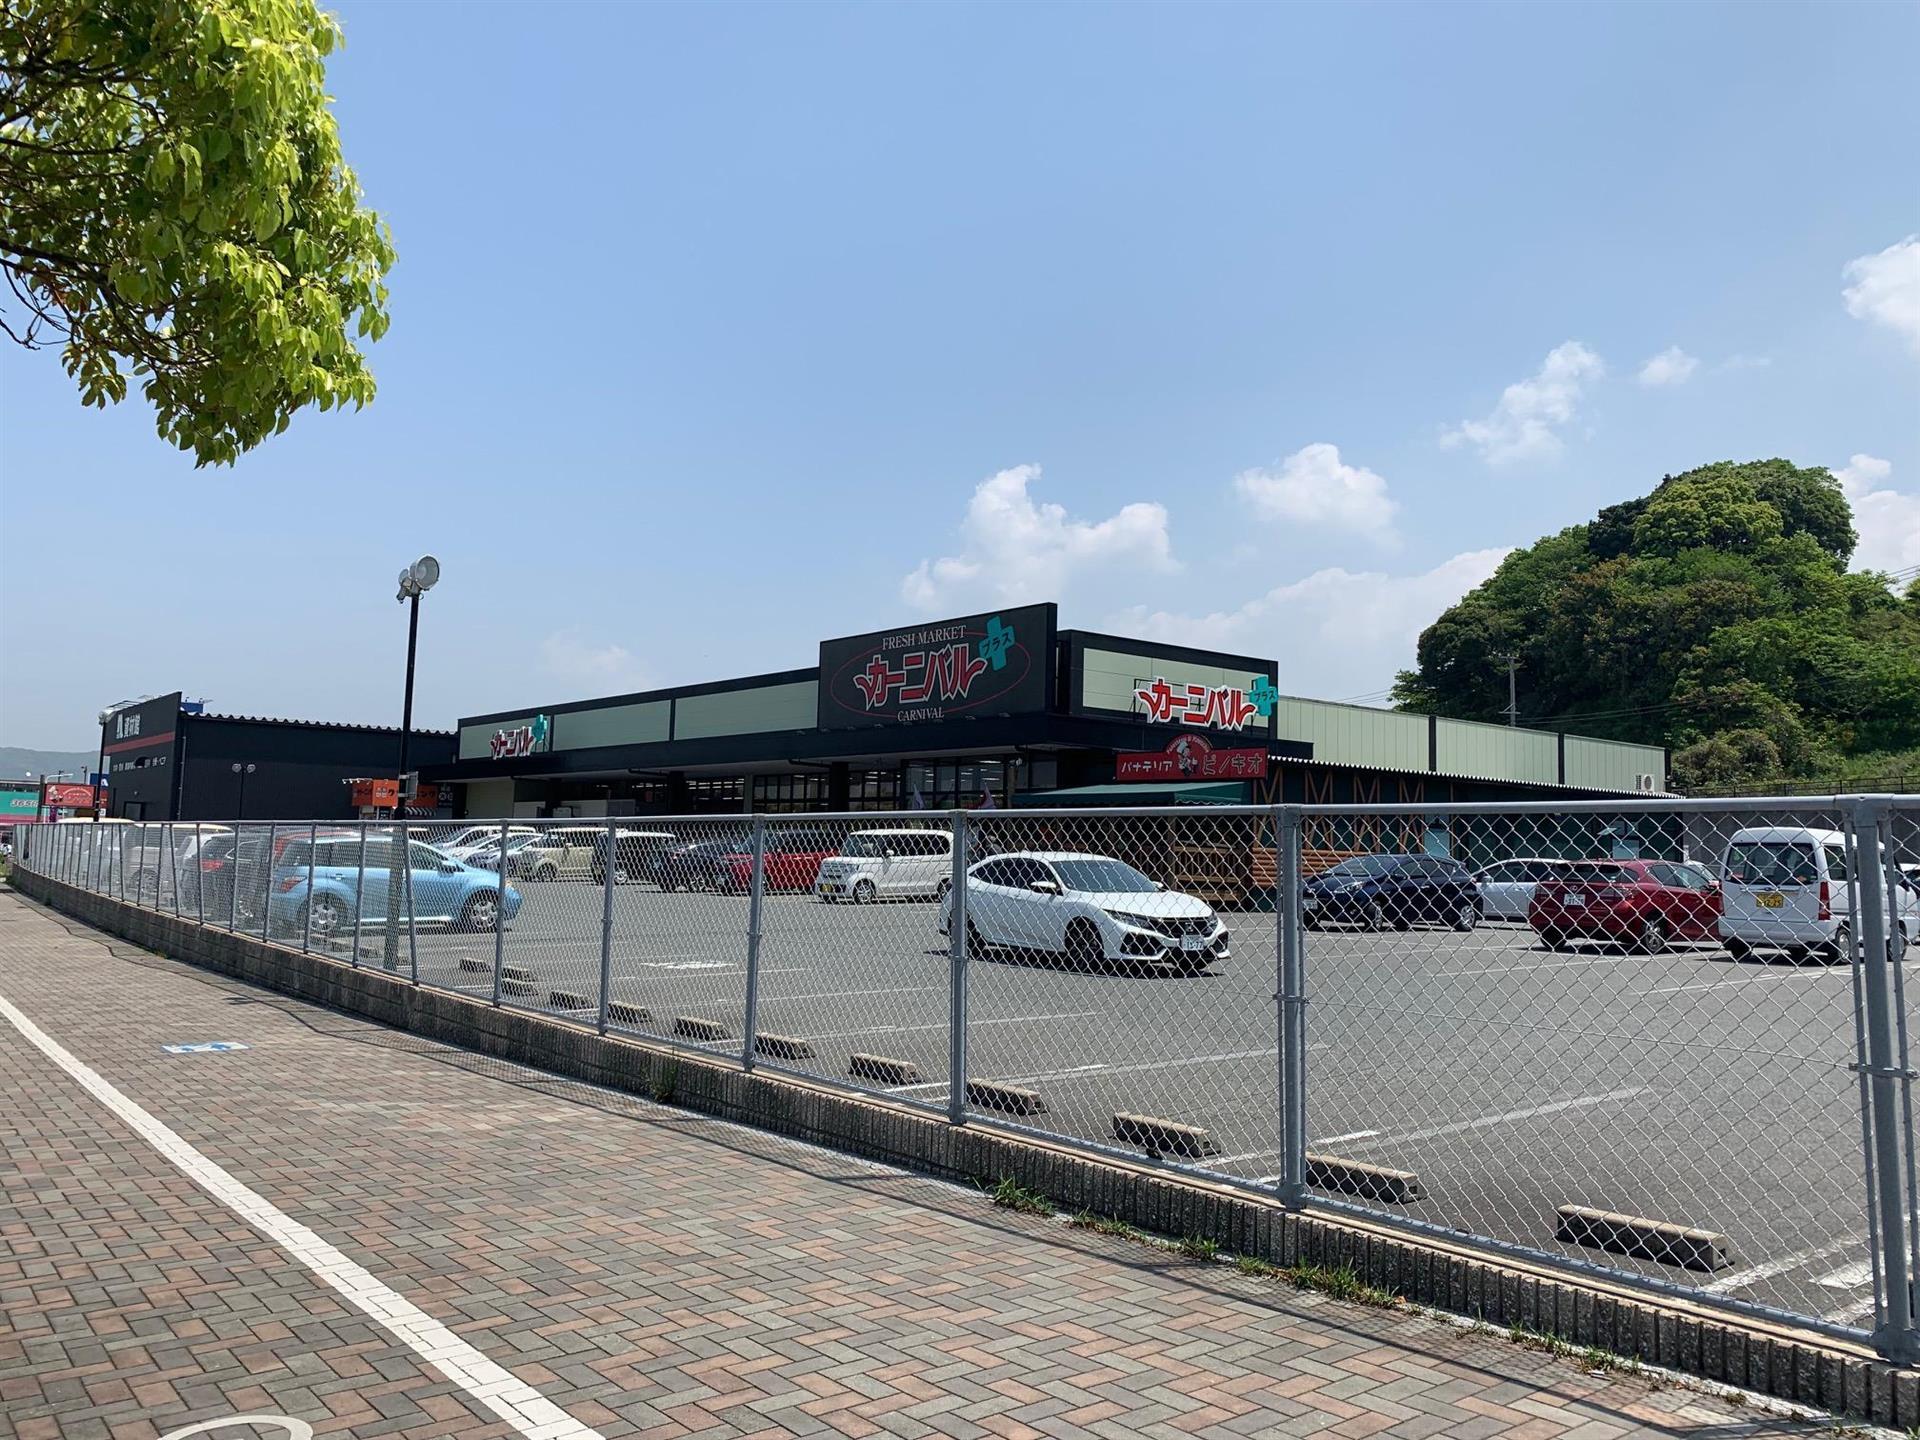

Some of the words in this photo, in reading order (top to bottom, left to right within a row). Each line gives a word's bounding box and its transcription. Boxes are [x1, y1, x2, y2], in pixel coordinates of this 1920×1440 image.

[882, 634, 916, 650] FRESH
[918, 625, 967, 645] MARKET
[982, 632, 1012, 657] プラス
[853, 643, 988, 711] カーニバル
[897, 706, 945, 722] CARNIVAL
[1134, 676, 1259, 731] カーニバル
[1202, 753, 1263, 775] ピノキオ
